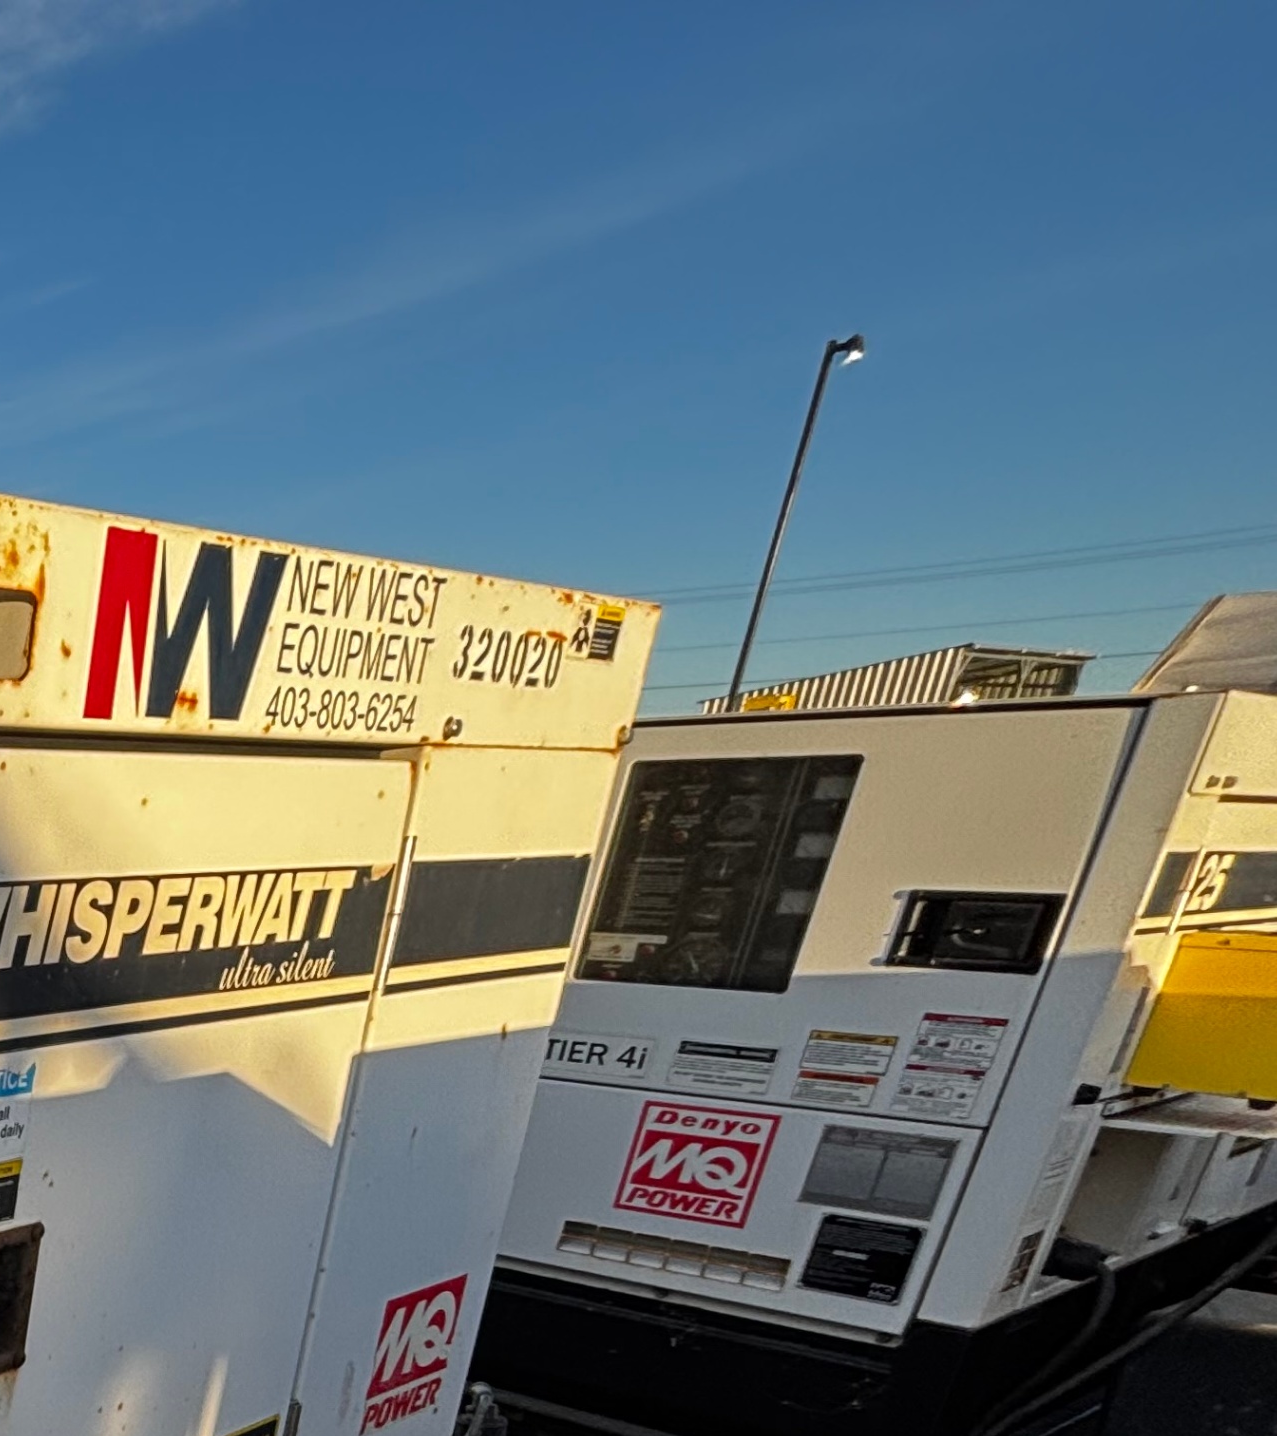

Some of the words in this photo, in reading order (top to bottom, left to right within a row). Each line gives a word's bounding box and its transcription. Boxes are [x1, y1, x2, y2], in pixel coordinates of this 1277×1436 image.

[286, 555, 365, 621] NEW
[366, 567, 448, 630] WEST
[276, 622, 436, 685] EQUIPMENT
[451, 624, 565, 688] 320020
[264, 686, 418, 733] 403-803-6254
[1185, 854, 1236, 911] 25
[219, 945, 274, 991] ultra
[275, 940, 335, 985] silent
[545, 1038, 609, 1066] TIER
[616, 1046, 649, 1070] 4i
[0, 1122, 24, 1139] daily
[654, 1109, 762, 1135] Denyo
[631, 1137, 748, 1197] MQ
[625, 1186, 740, 1220] POWER
[372, 1290, 457, 1382] MQ
